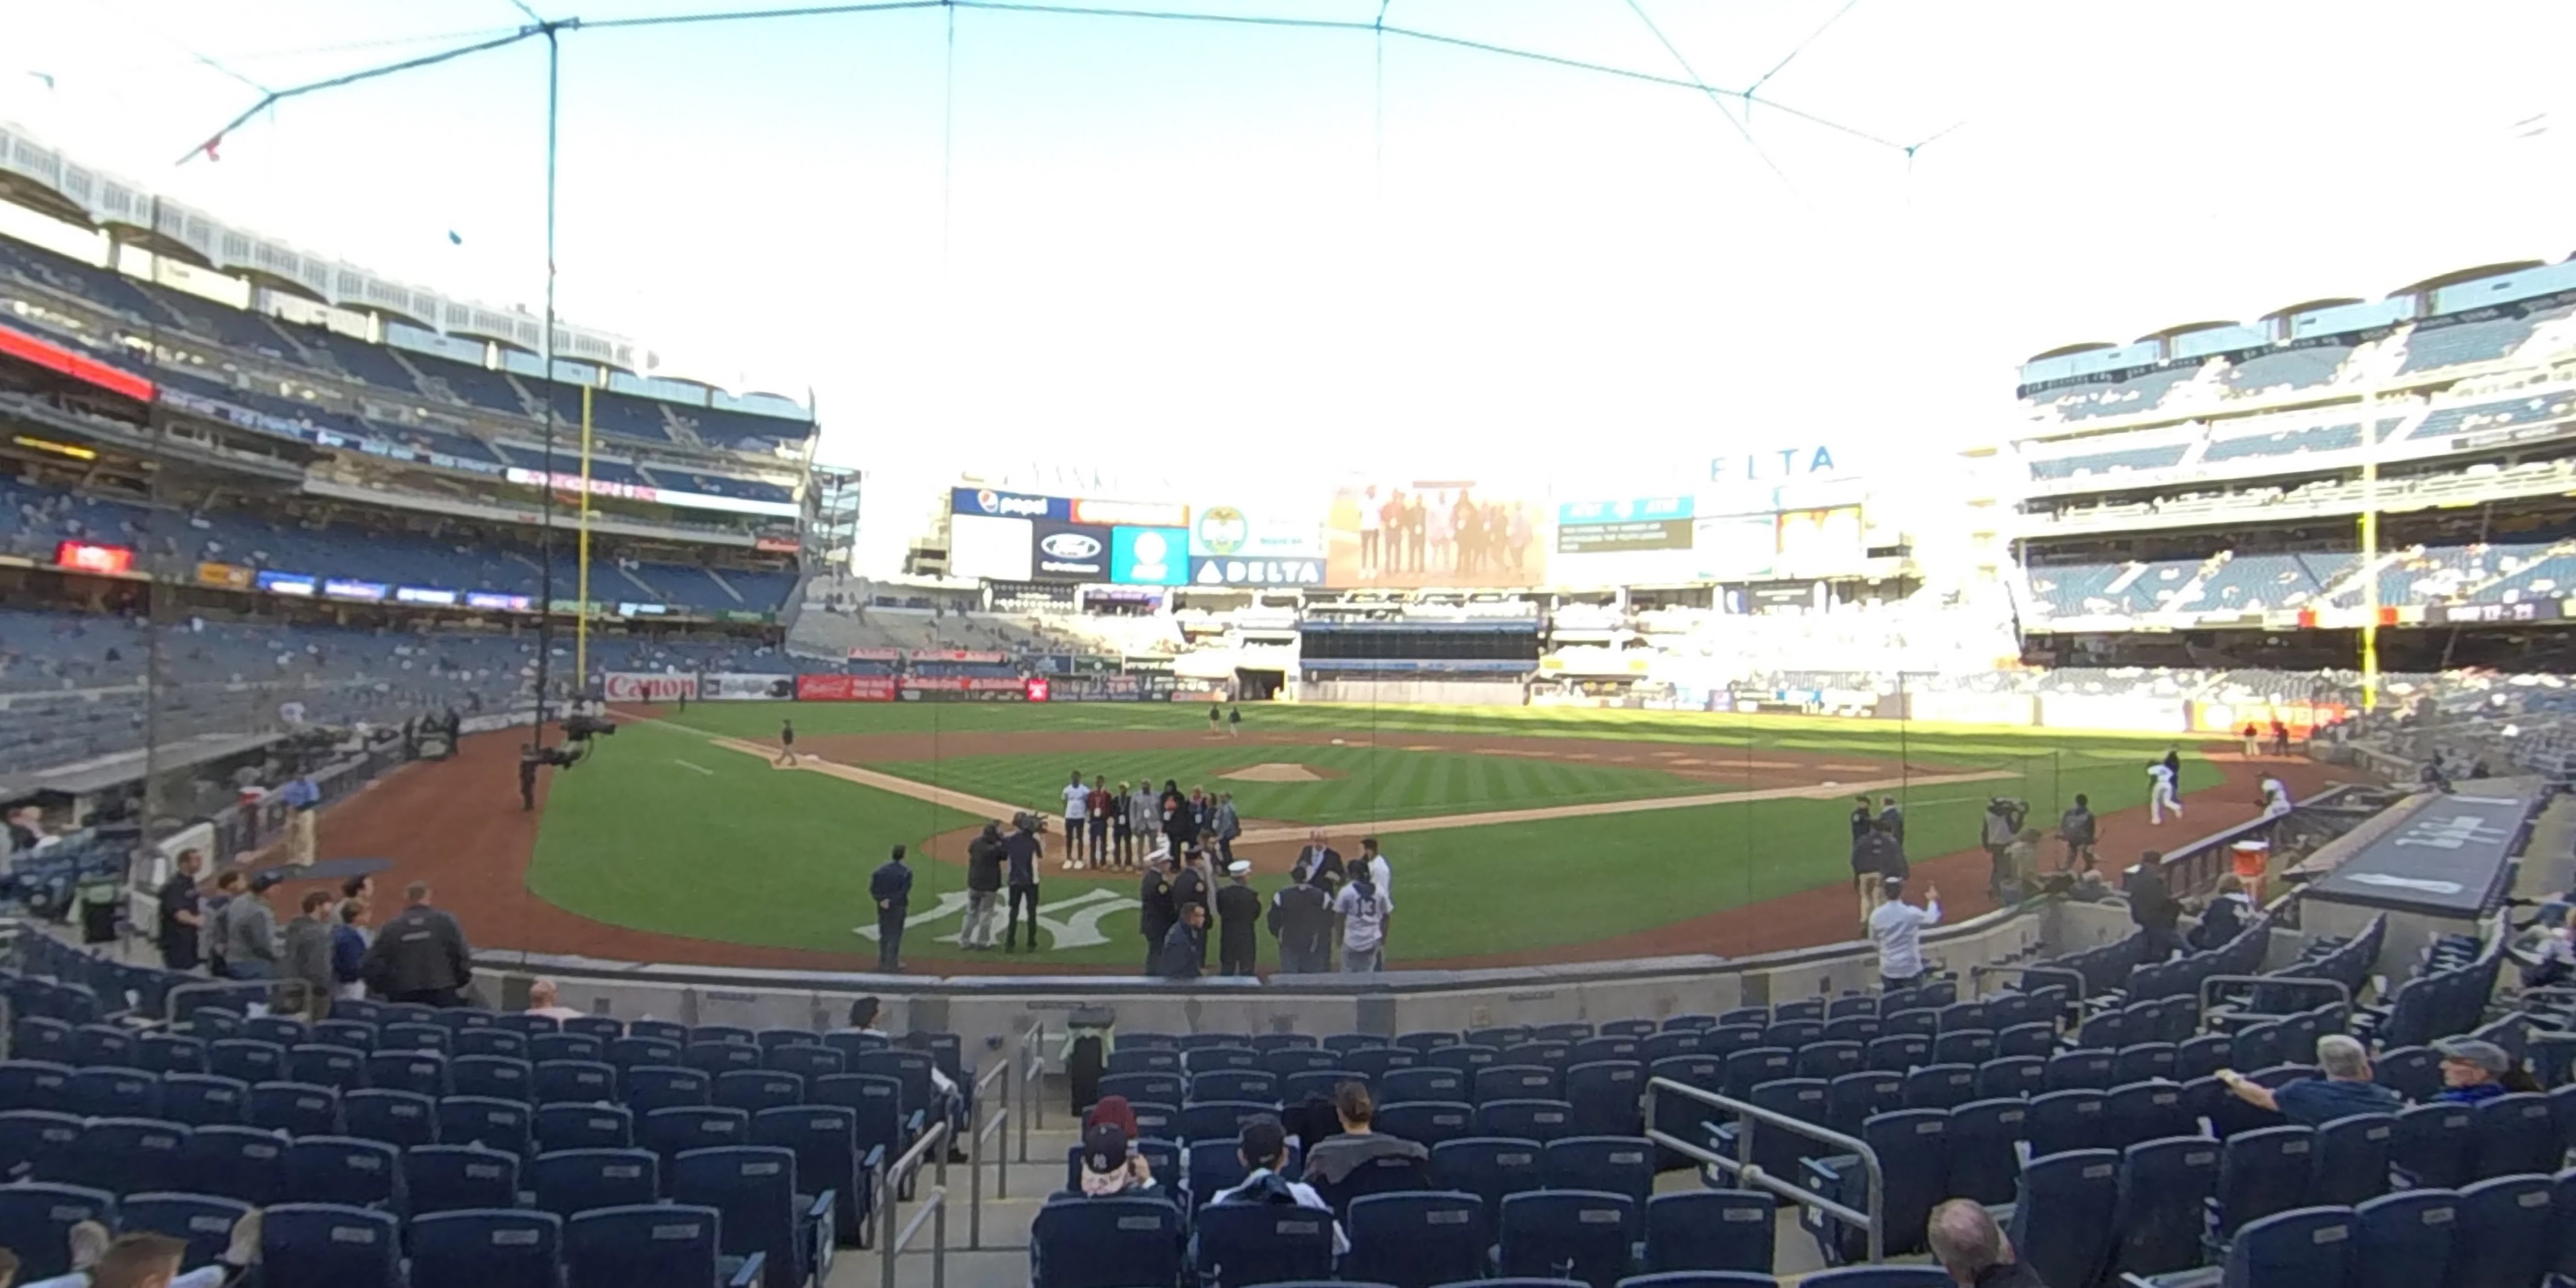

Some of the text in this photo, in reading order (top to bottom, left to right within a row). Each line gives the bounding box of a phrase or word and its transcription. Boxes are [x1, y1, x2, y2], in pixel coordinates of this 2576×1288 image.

[1227, 561, 1319, 583] DELTA
[608, 675, 695, 698] Canon
[1356, 898, 1376, 917] 13
